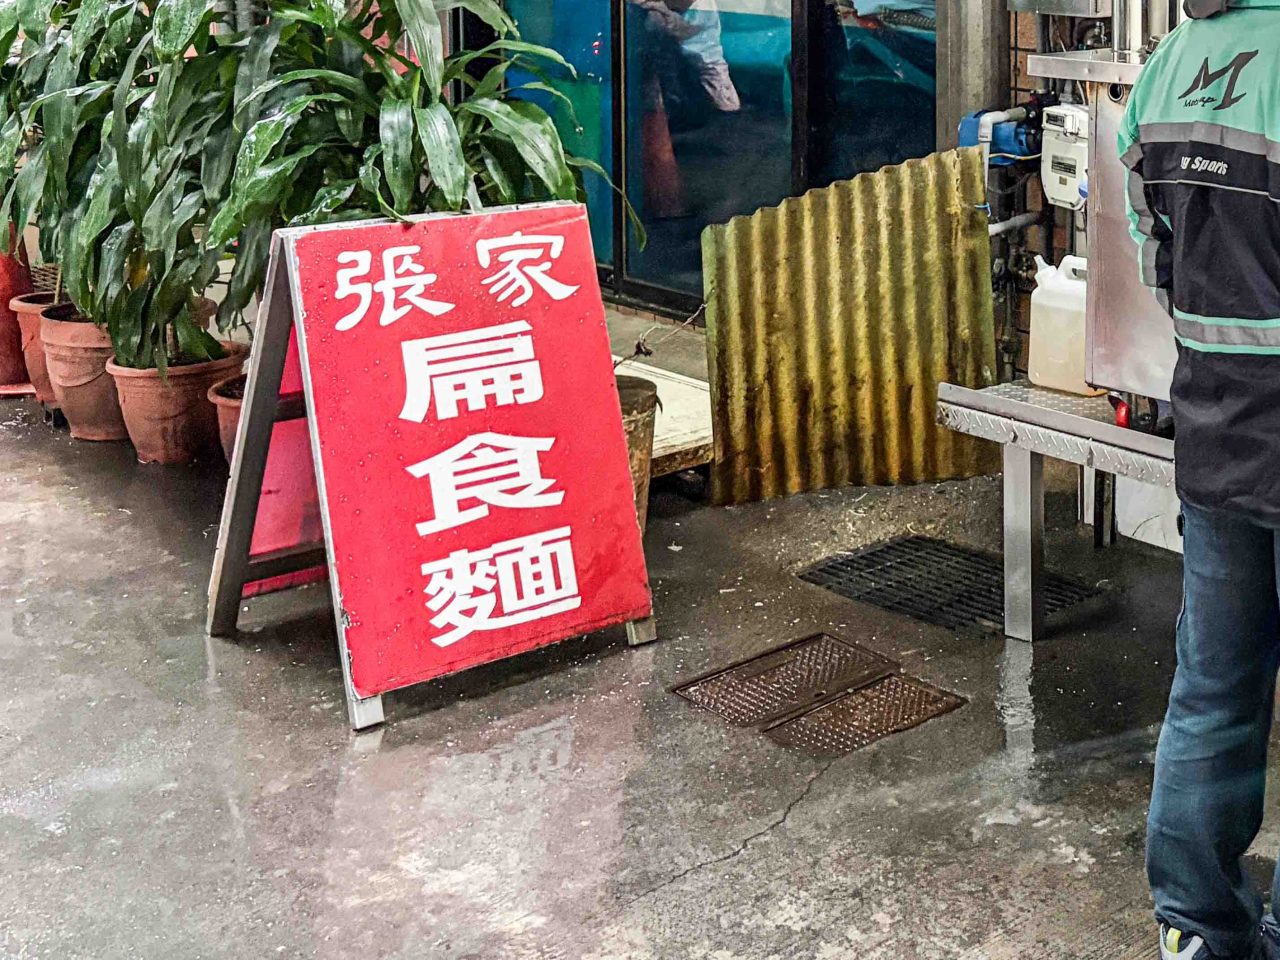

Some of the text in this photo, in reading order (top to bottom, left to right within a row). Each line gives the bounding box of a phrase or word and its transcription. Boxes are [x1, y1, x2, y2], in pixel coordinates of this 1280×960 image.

[1192, 156, 1228, 175] Sports
[334, 231, 581, 332] 張家
[398, 319, 582, 649] 扁食麵
